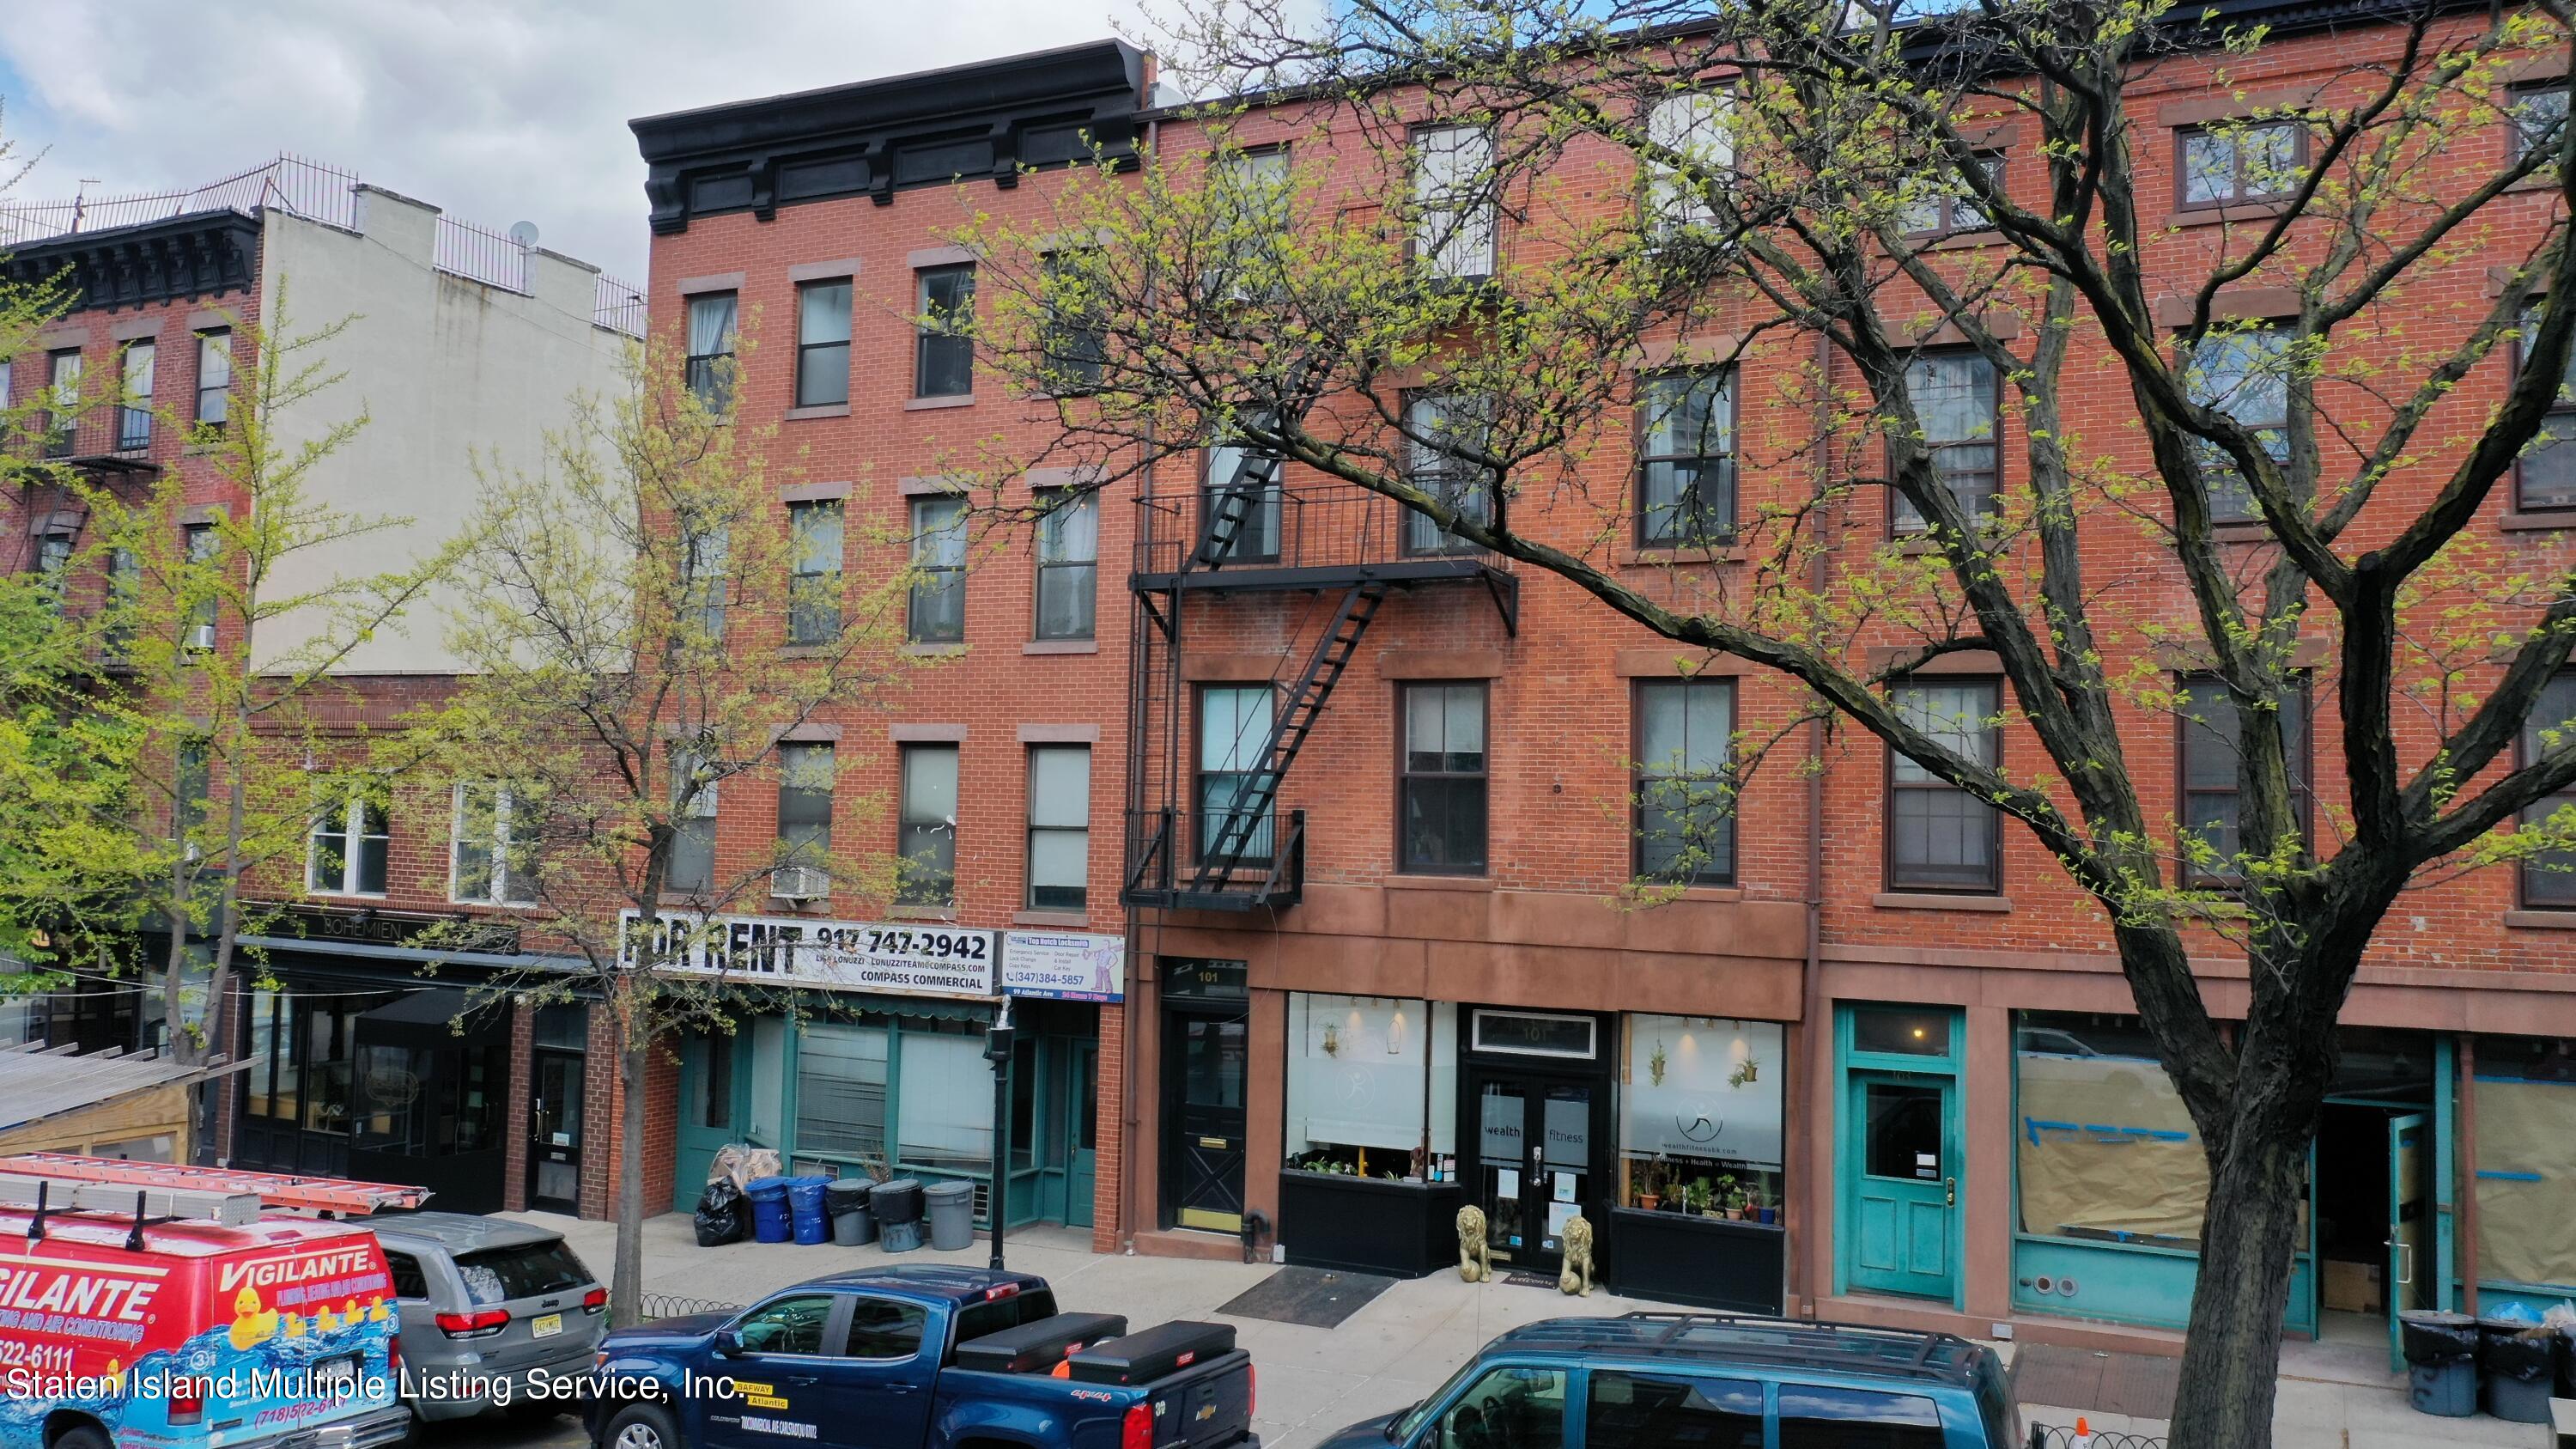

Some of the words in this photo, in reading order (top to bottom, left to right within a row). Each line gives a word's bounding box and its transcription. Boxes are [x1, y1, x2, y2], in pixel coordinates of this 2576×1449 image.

[704, 921, 803, 974] RENT
[817, 927, 860, 951] 917
[868, 930, 986, 959] 747-2942
[1028, 937, 1040, 946] Top
[1058, 939, 1089, 948] Locksmith
[861, 971, 910, 984] COMPASS
[913, 975, 983, 989] COMMERCIAL
[1015, 971, 1084, 985] (347)384-5857
[1198, 971, 1218, 983] 101
[1485, 1125, 1521, 1138] wealth
[1549, 1129, 1583, 1144] fitness
[1691, 1158, 1713, 1167] Health
[1721, 1160, 1747, 1169] Wealth
[219, 1245, 369, 1292] VIGILANTE
[18, 1312, 45, 1331] AND
[42, 1314, 64, 1334] AIR
[64, 1316, 145, 1343] CONDITIONING
[751, 1397, 786, 1408] Atlantic
